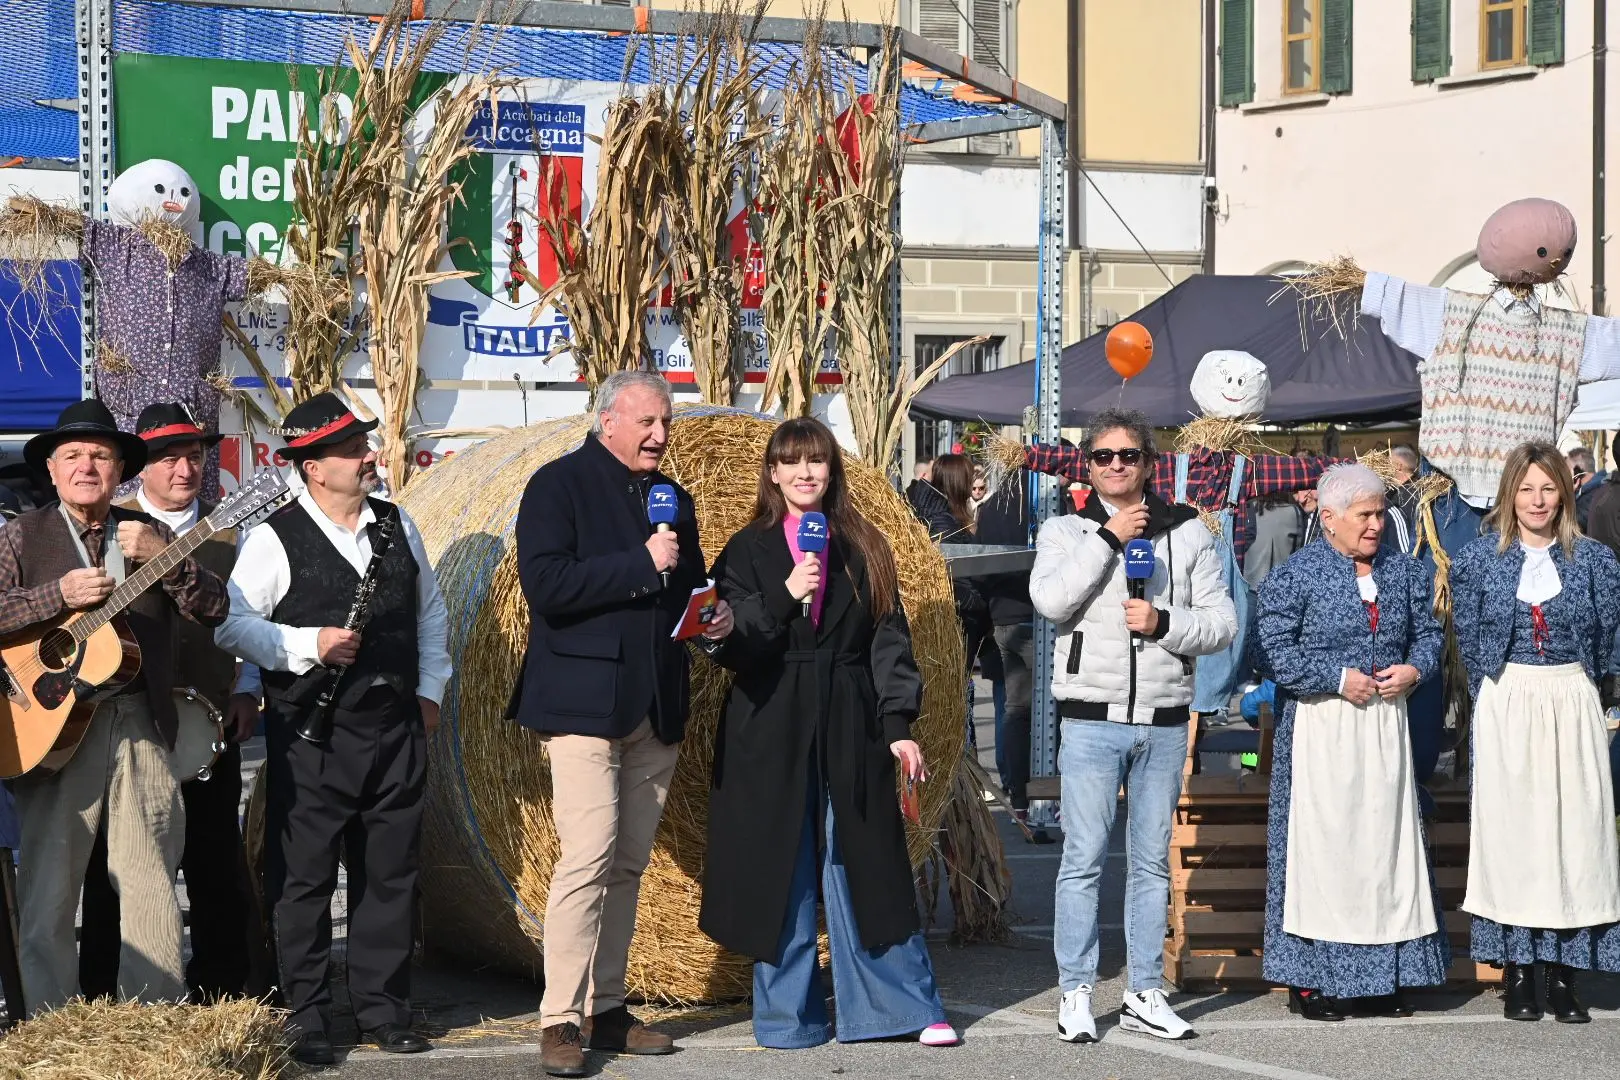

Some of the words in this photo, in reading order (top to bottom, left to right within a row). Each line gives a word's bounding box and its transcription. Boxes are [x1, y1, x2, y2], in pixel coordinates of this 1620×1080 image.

[211, 86, 353, 147] PALO
[554, 110, 582, 124] della
[467, 325, 566, 354] ITALIA
[666, 354, 686, 368] Gli
